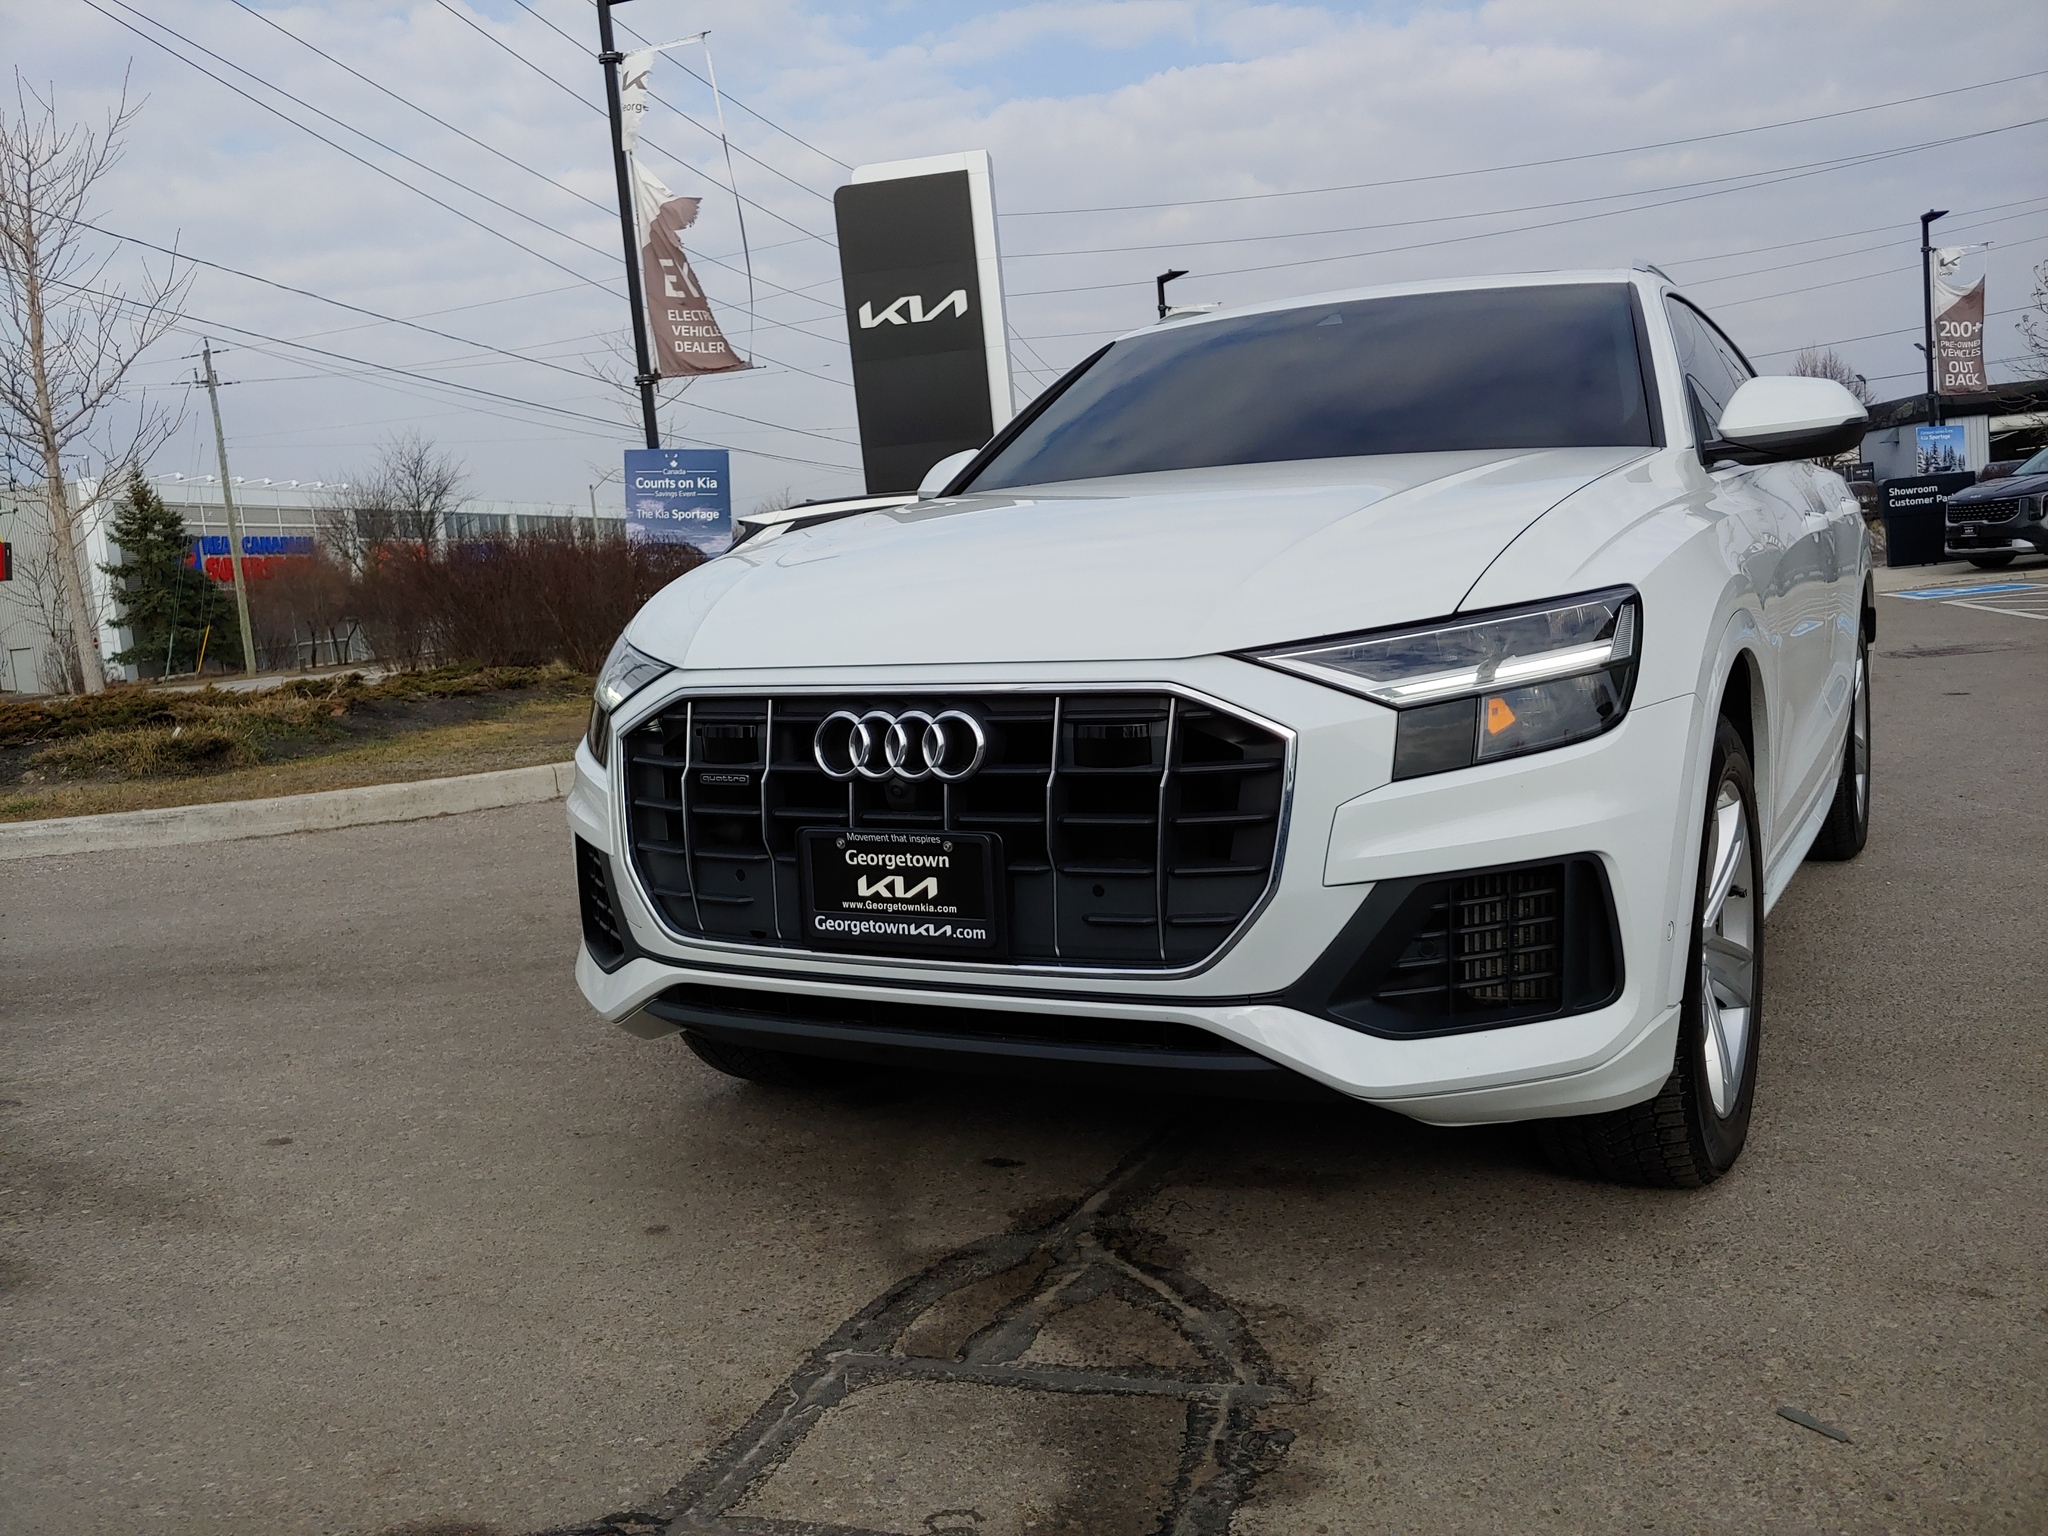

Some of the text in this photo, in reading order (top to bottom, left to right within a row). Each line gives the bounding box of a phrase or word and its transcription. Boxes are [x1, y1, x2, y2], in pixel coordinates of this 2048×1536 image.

[859, 289, 968, 329] KIA
[1939, 321, 1983, 337] 200+
[675, 341, 725, 353] DEALER
[1940, 340, 1980, 348] PRE-OWNED
[1940, 347, 1981, 358] VEHICLES
[1948, 361, 1975, 374] OUT
[1945, 373, 1981, 386] BACK
[635, 477, 718, 489] Counts on Kia
[1888, 485, 1938, 497] Showroom
[1889, 497, 1934, 508] Customer
[636, 509, 720, 521] The Kia Sportage
[846, 832, 941, 844] Movement that inspires
[845, 849, 950, 870] Georgetown
[857, 874, 938, 900] KIA
[842, 900, 957, 914] www.Georgetownkia.com
